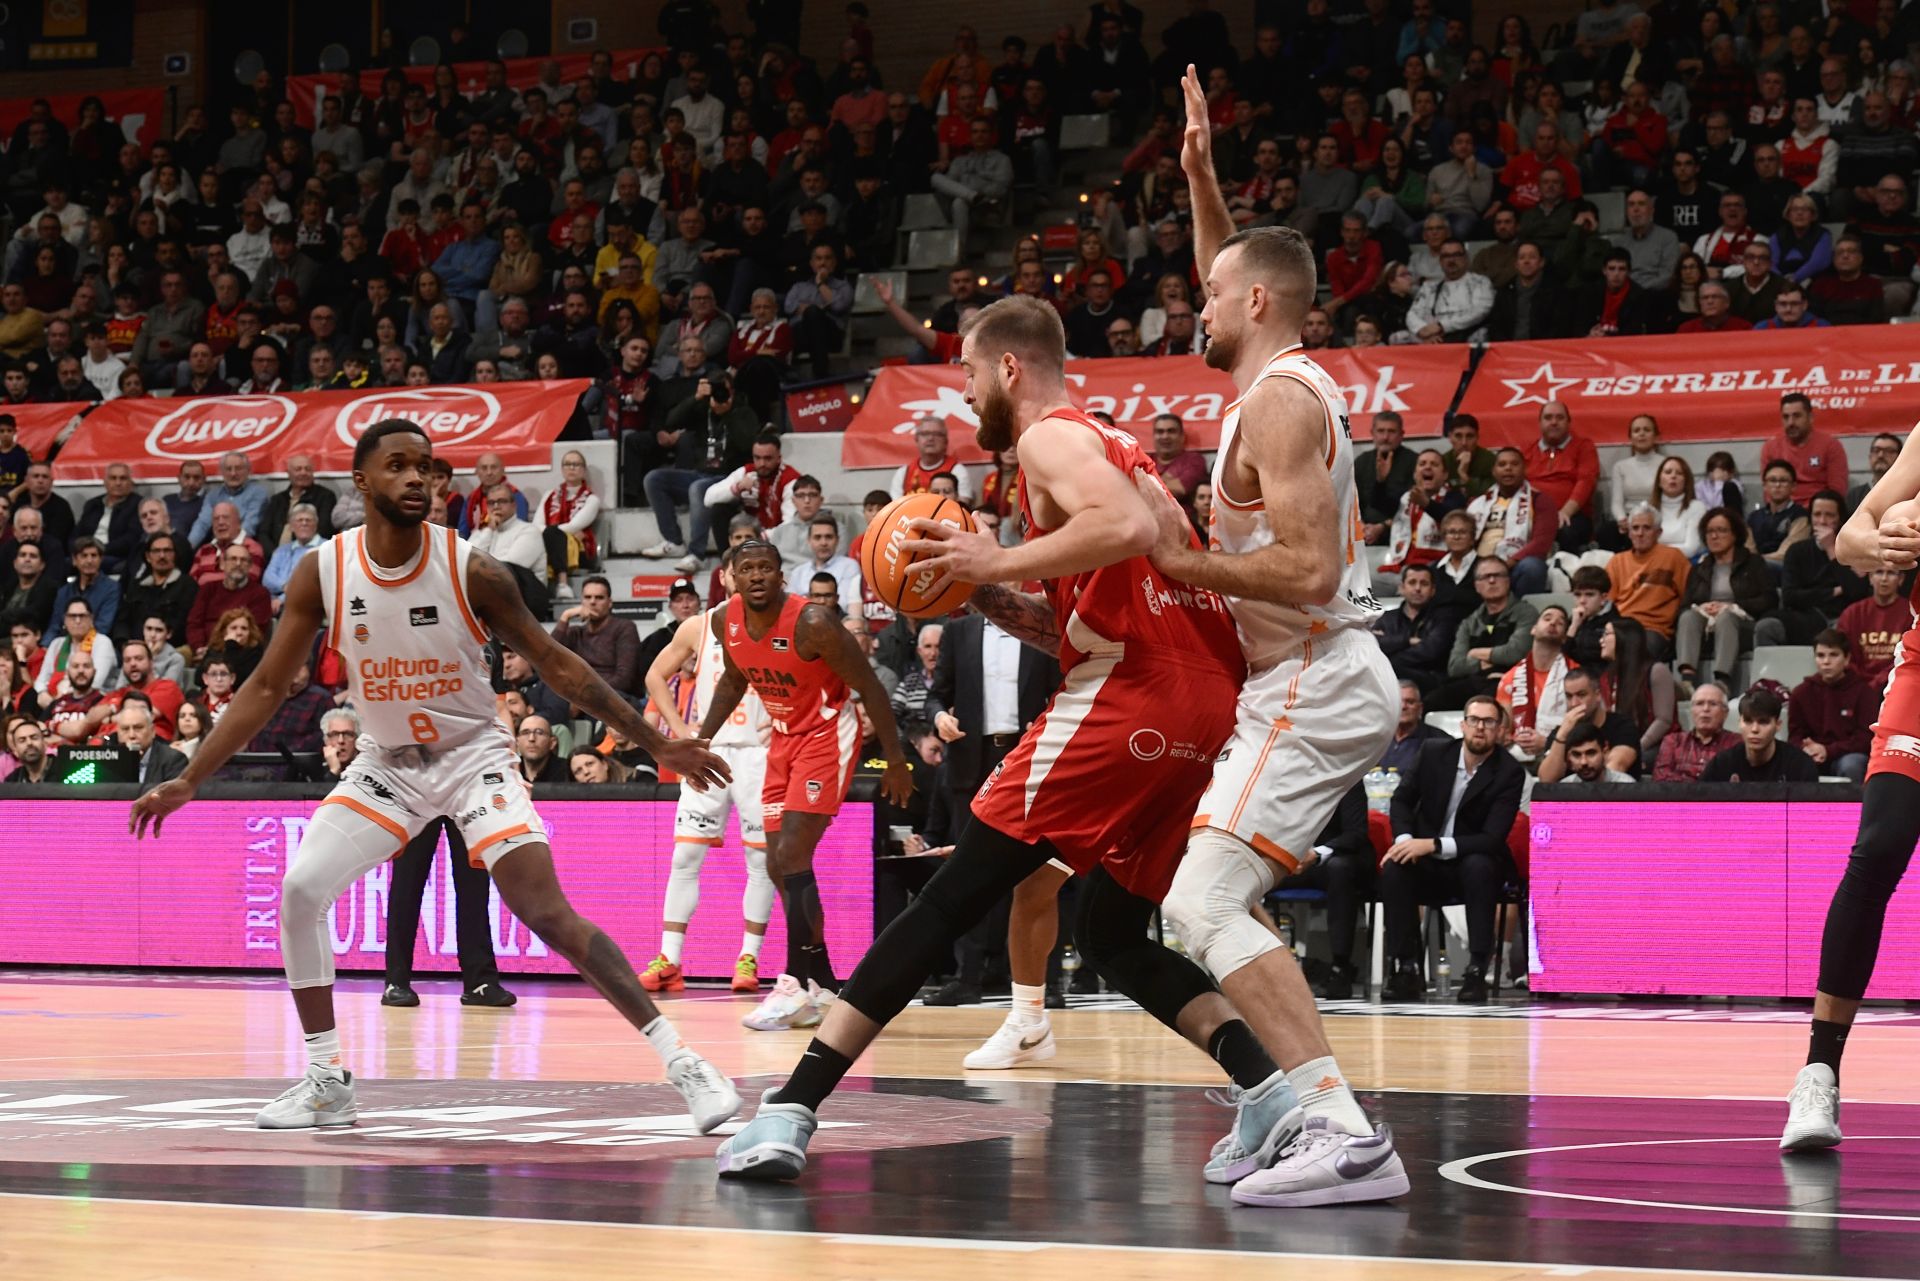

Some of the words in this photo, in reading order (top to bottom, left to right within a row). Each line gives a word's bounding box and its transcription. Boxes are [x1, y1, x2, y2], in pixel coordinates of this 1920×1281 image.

[1063, 366, 1414, 422] aixank
[1581, 365, 1829, 397] ESTRELLA
[1840, 369, 1871, 381] DE
[798, 398, 842, 417] MÓDULO
[162, 414, 279, 444] Juver
[360, 656, 439, 679] Cultura
[441, 660, 462, 674] del
[362, 678, 463, 702] Esfuerzo
[408, 712, 439, 744] 8
[69, 748, 119, 760] POSESIÓN
[246, 816, 278, 950] FRUTAS
